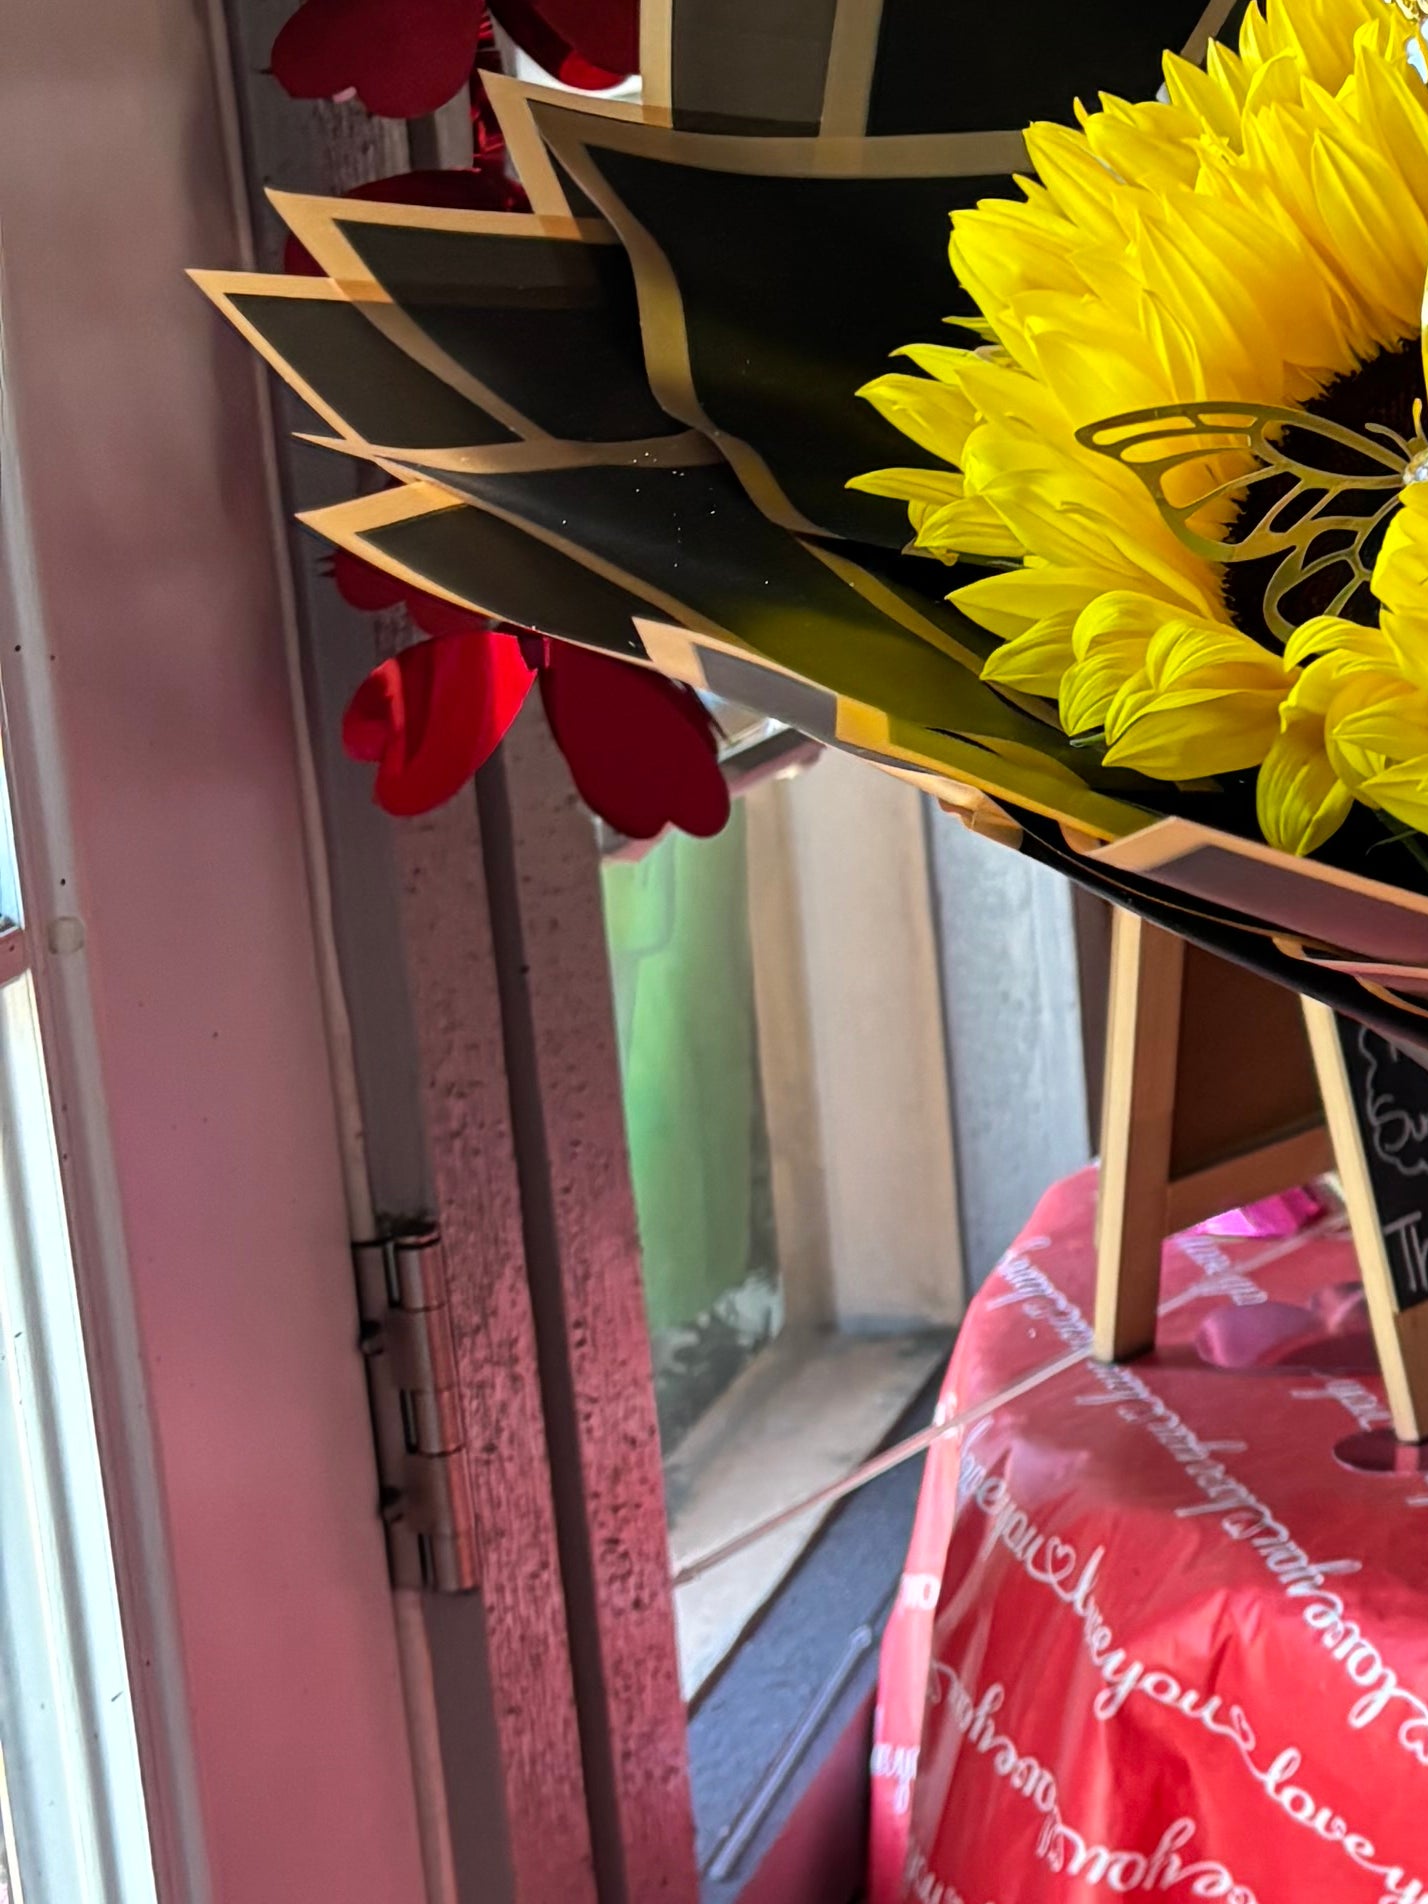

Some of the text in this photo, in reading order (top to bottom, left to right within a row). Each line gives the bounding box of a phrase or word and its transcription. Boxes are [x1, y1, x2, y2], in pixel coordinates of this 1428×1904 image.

[1302, 1596, 1397, 1729] love
[1094, 1649, 1225, 1721] you
[1264, 1747, 1376, 1864] love
[1066, 1817, 1196, 1893] you
